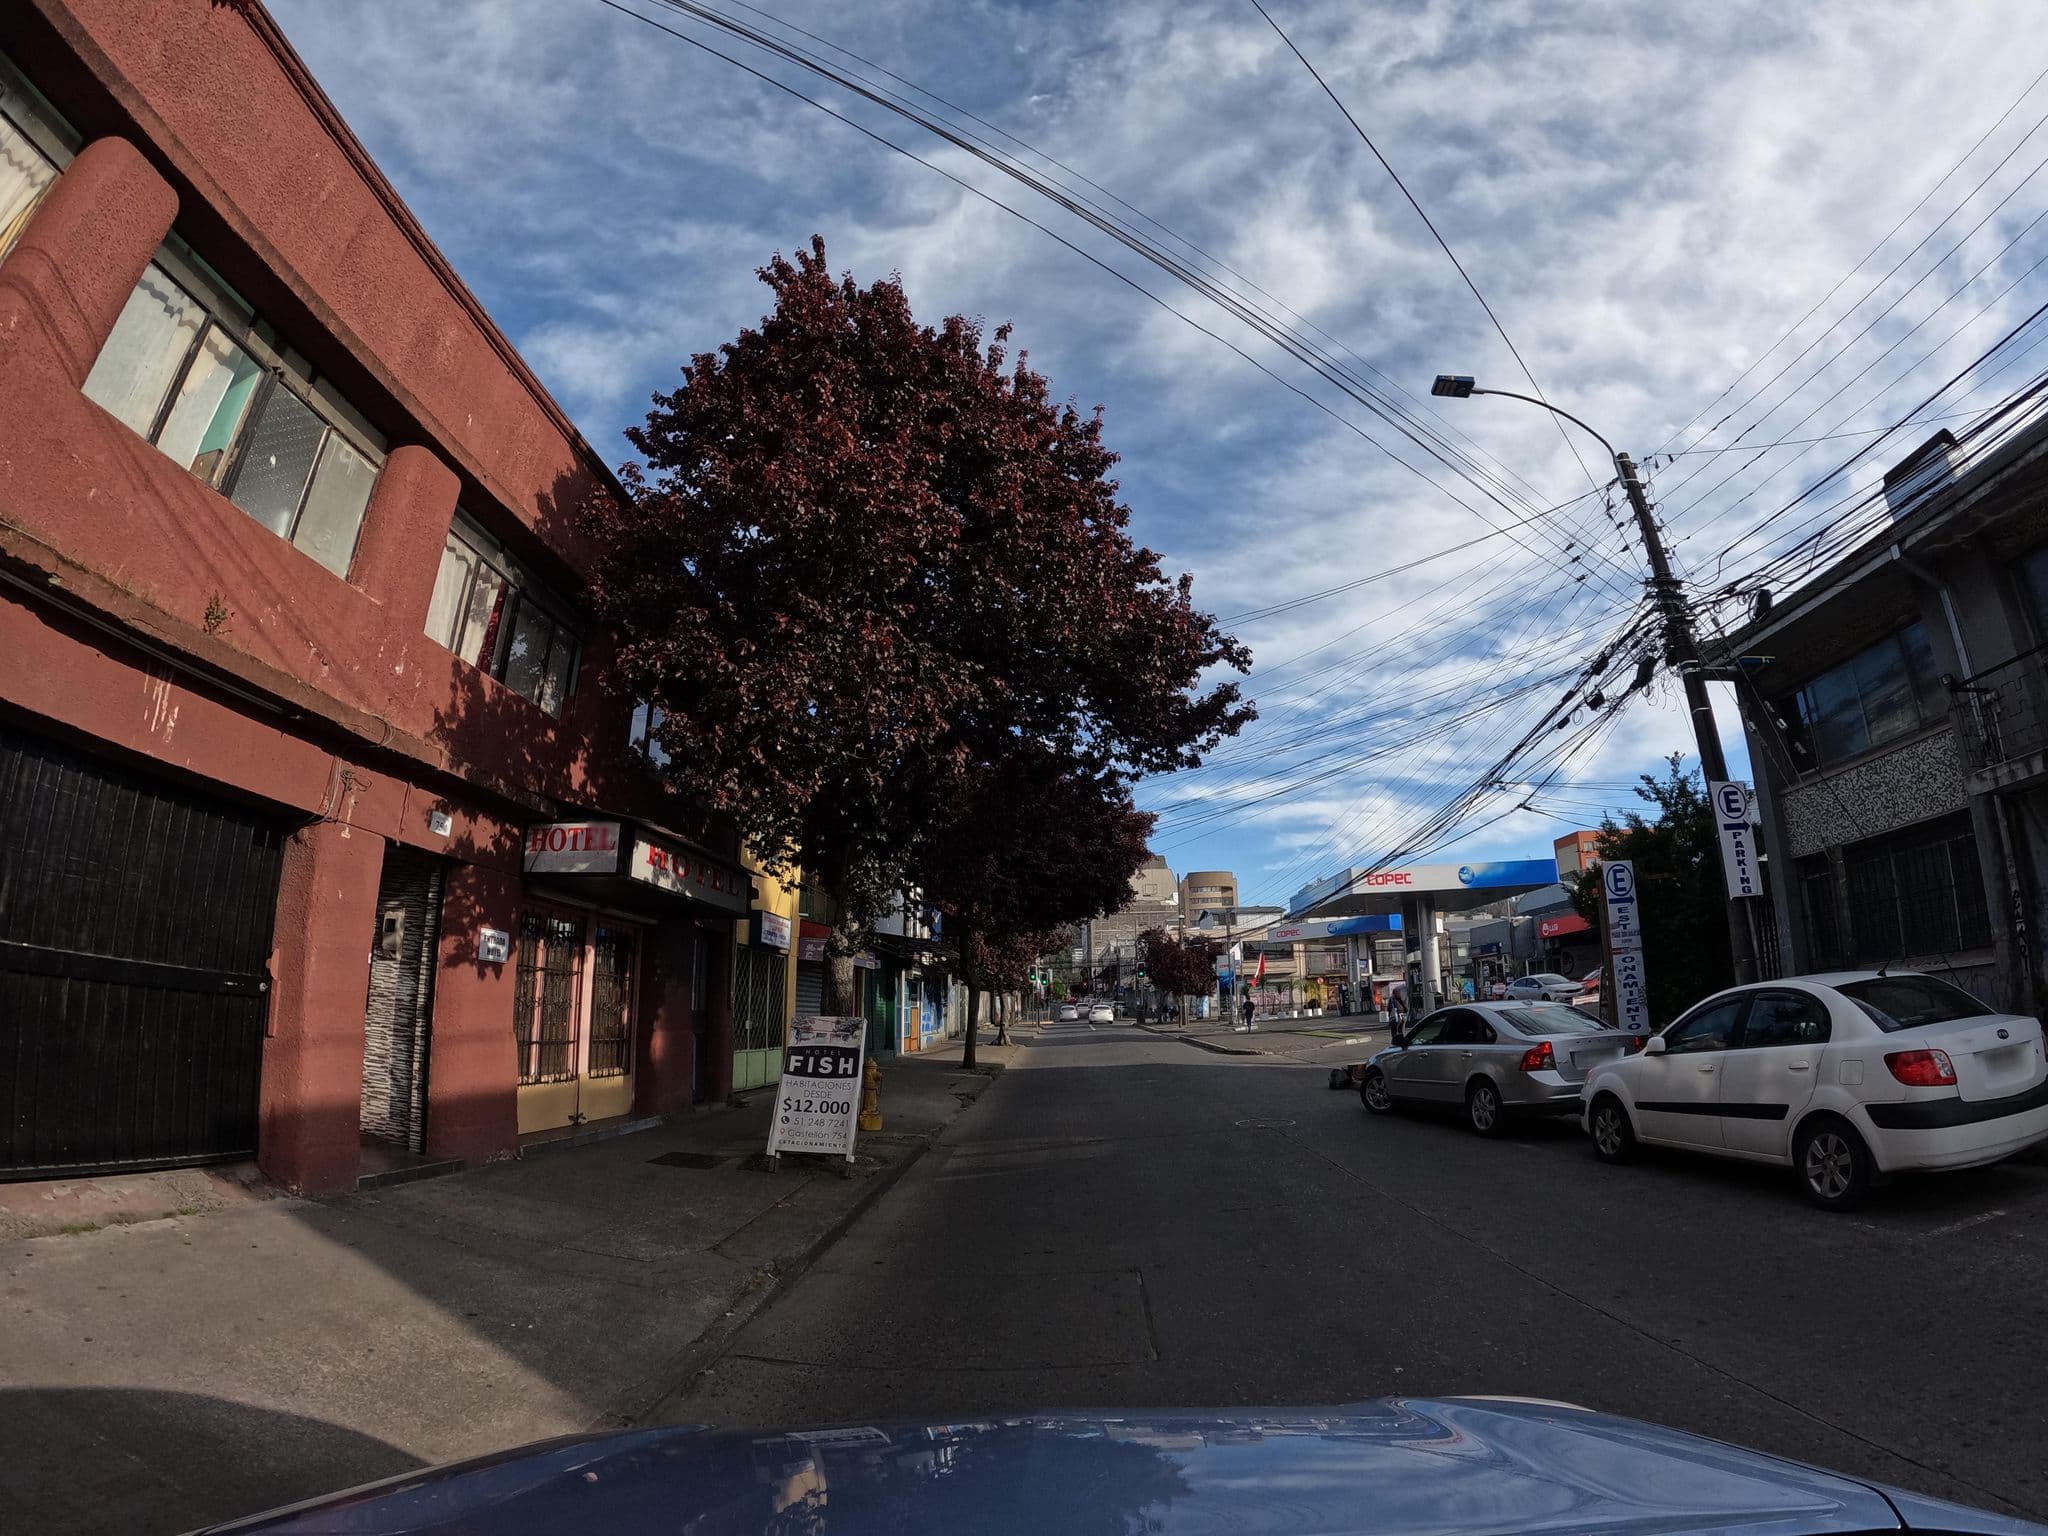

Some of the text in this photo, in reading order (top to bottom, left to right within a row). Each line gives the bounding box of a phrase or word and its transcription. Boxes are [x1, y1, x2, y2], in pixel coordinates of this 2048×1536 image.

[1732, 831, 1753, 895] PARKING
[646, 843, 739, 897] HOTEL
[805, 1048, 841, 1056] HOTEL
[788, 1055, 854, 1075] FISH
[785, 1079, 852, 1091] HABITACIONES
[803, 1089, 832, 1099] DESDE
[782, 1096, 851, 1115] $12.000
[793, 1117, 849, 1128] 51 248 7241
[832, 1131, 847, 1140] 754
[778, 1139, 847, 1149] ESTACIONAMIENTO
